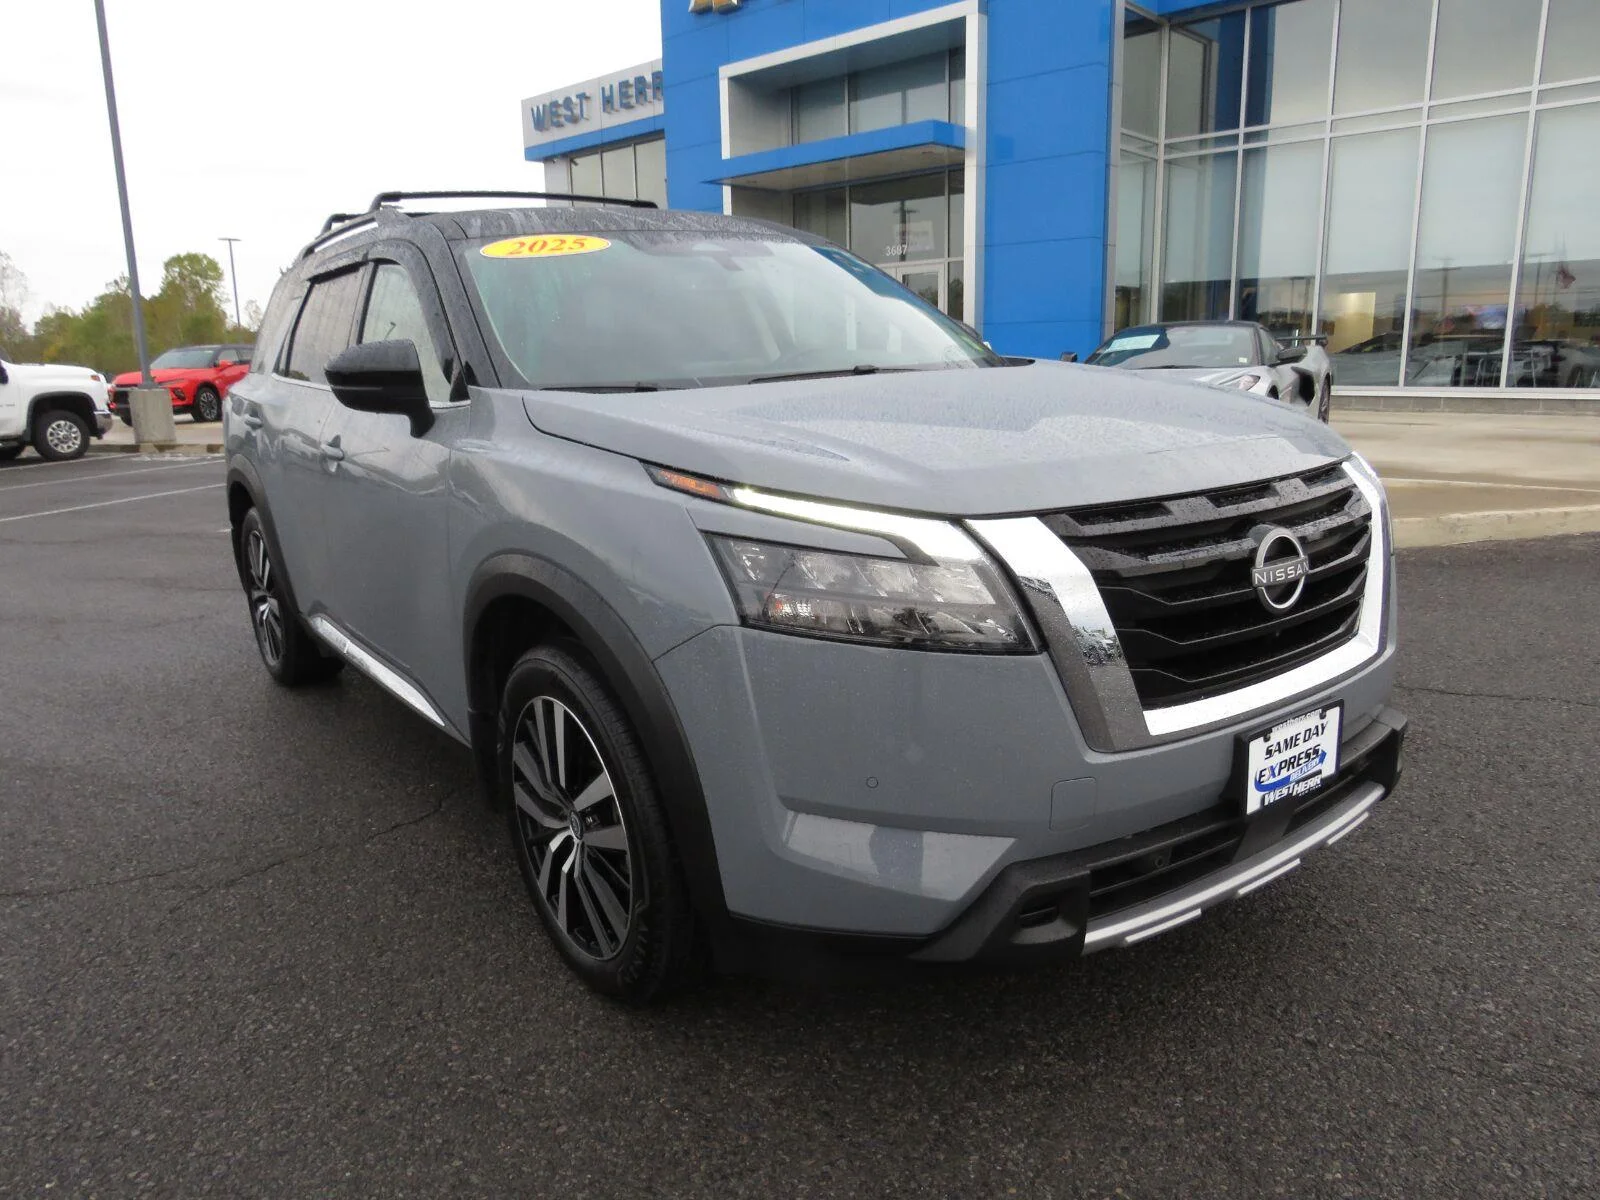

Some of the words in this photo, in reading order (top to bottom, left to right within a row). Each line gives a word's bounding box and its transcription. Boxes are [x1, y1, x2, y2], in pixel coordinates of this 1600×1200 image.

[531, 92, 589, 132] WEST
[601, 71, 664, 113] HERR
[505, 238, 588, 256] 2025
[886, 244, 907, 256] 3687
[1254, 562, 1308, 584] NISSAN
[1265, 733, 1301, 760] SAME
[1303, 721, 1328, 743] DAY
[1258, 744, 1320, 784] EXPRESS
[1263, 783, 1295, 806] WEST
[1292, 775, 1322, 797] HERR
